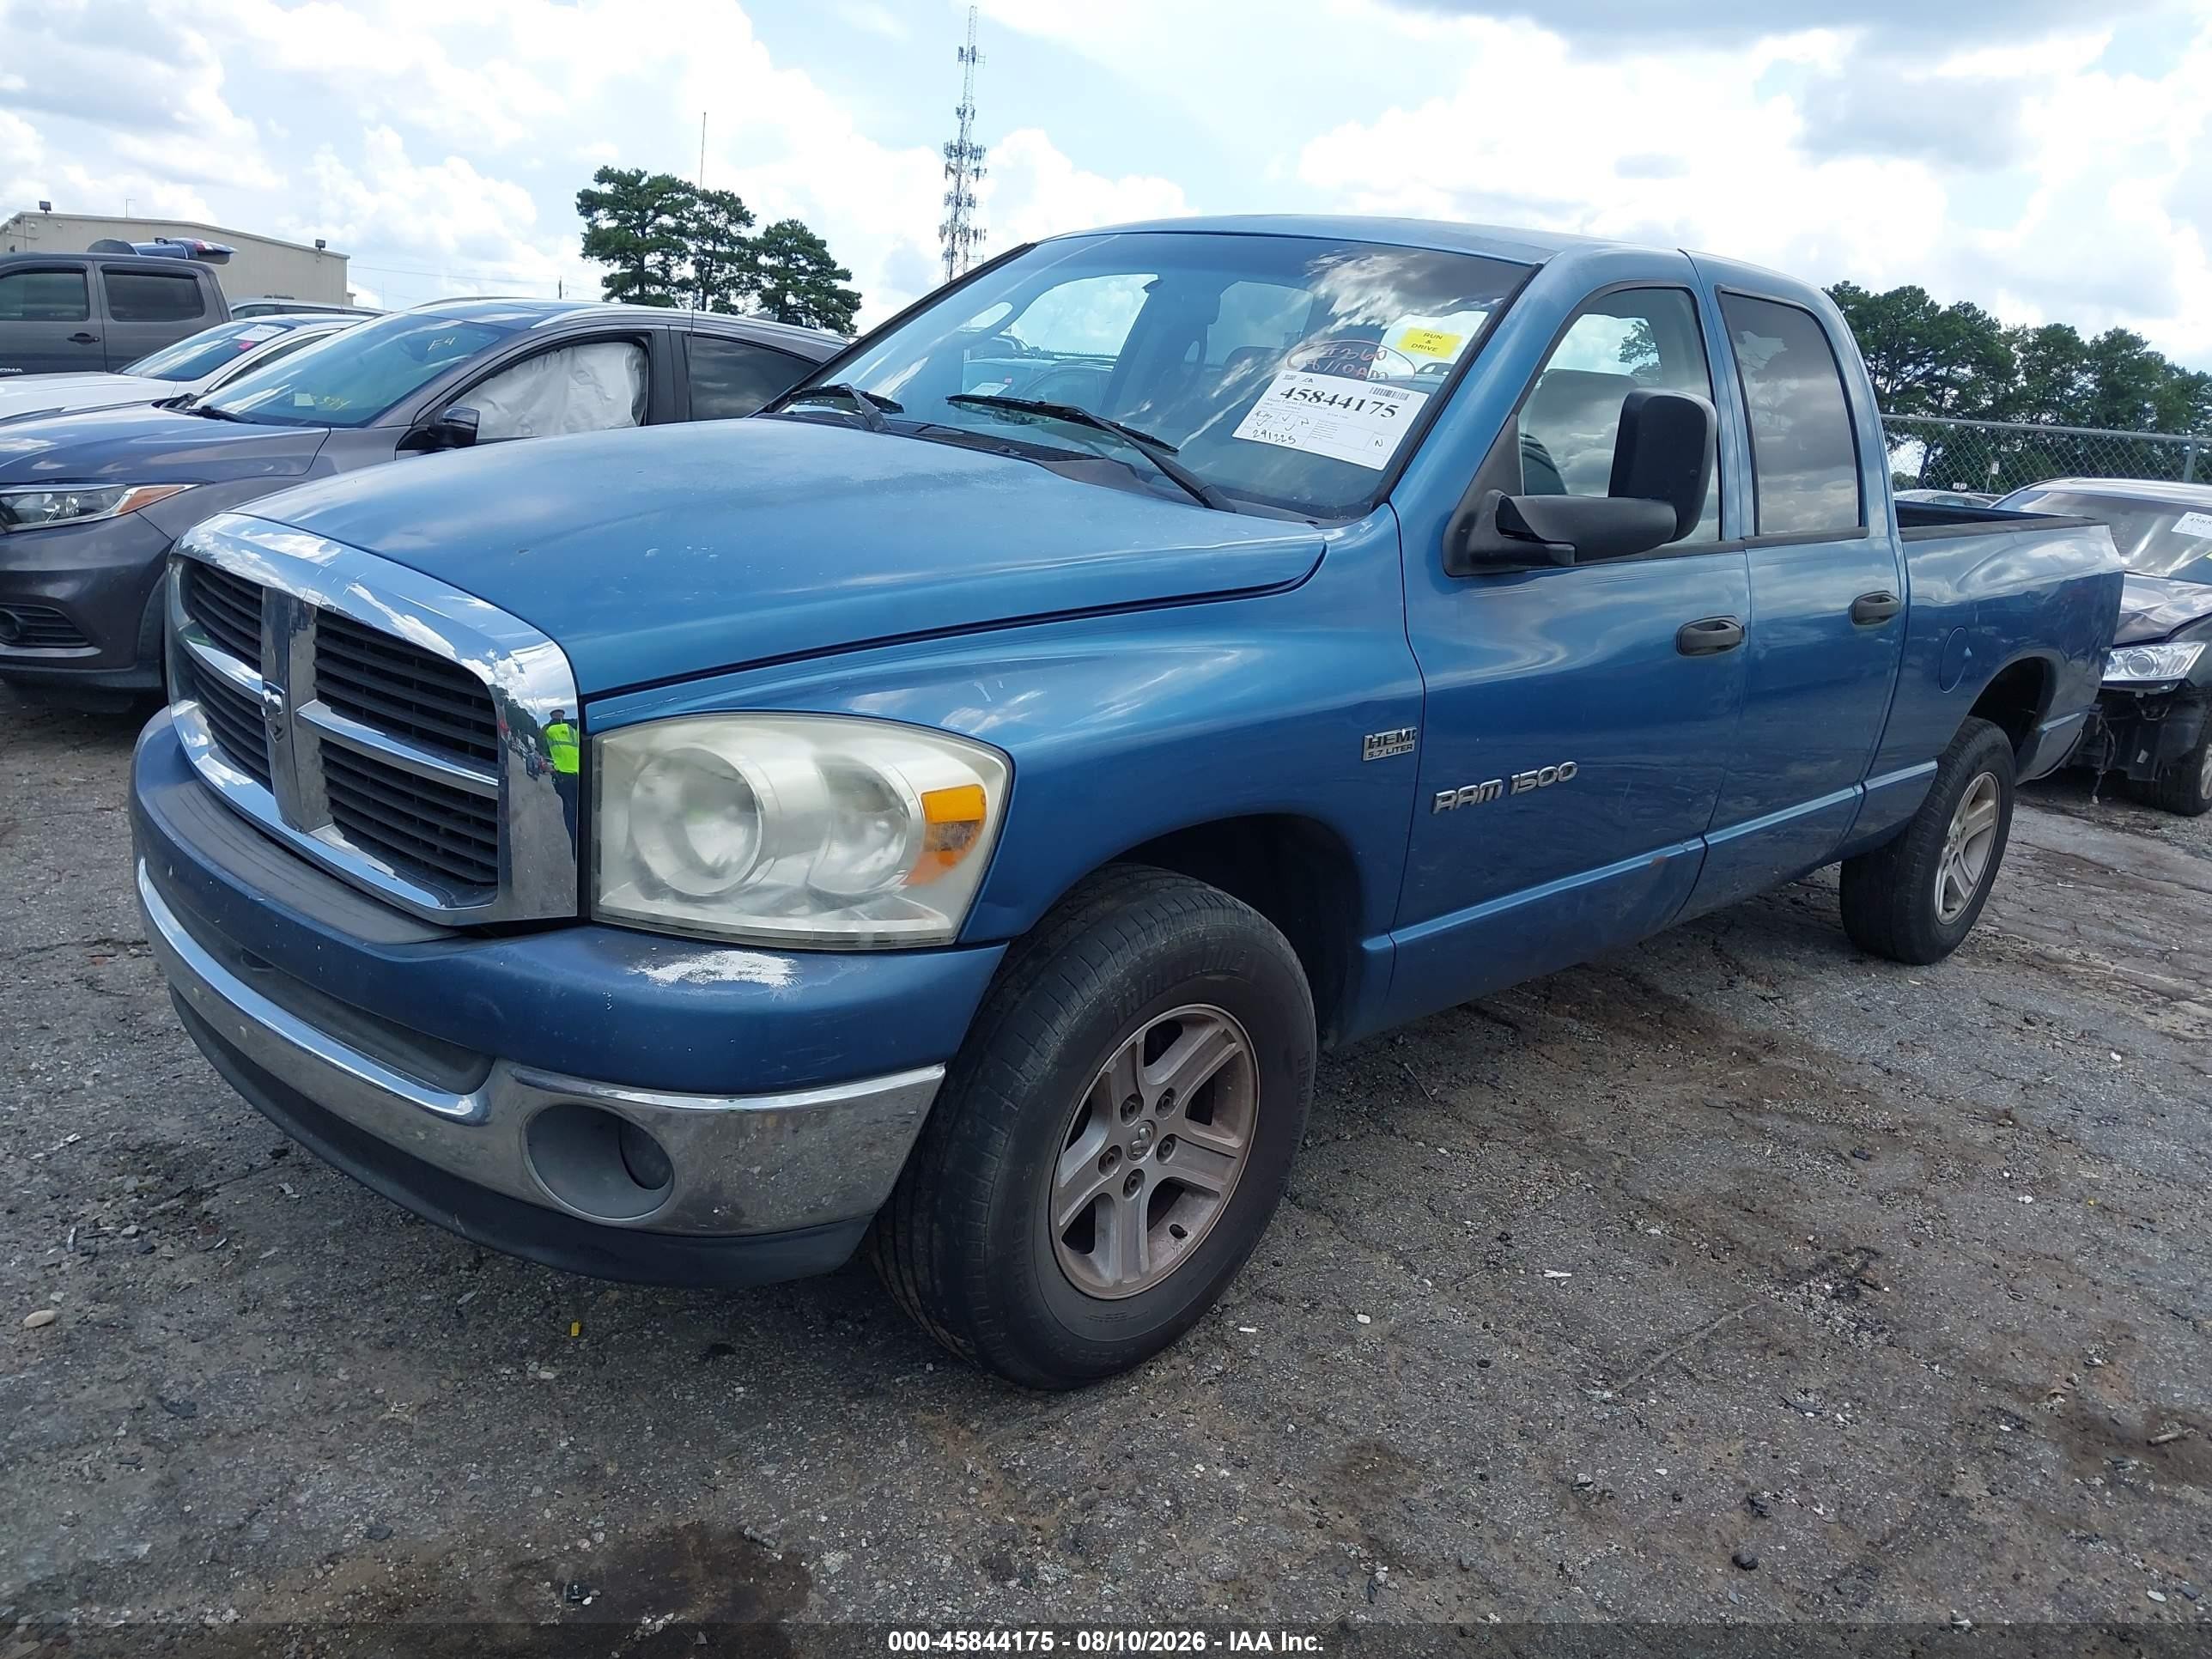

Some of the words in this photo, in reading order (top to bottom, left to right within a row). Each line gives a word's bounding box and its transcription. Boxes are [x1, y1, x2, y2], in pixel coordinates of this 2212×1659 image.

[1411, 343, 1439, 352] DRIVE
[1279, 386, 1400, 418] 45844175
[1298, 402, 1328, 410] Insurance
[1368, 729, 1417, 749] HEMI
[1386, 744, 1413, 755] LITER
[1432, 779, 1504, 815] RAM
[1510, 761, 1578, 796] 1500
